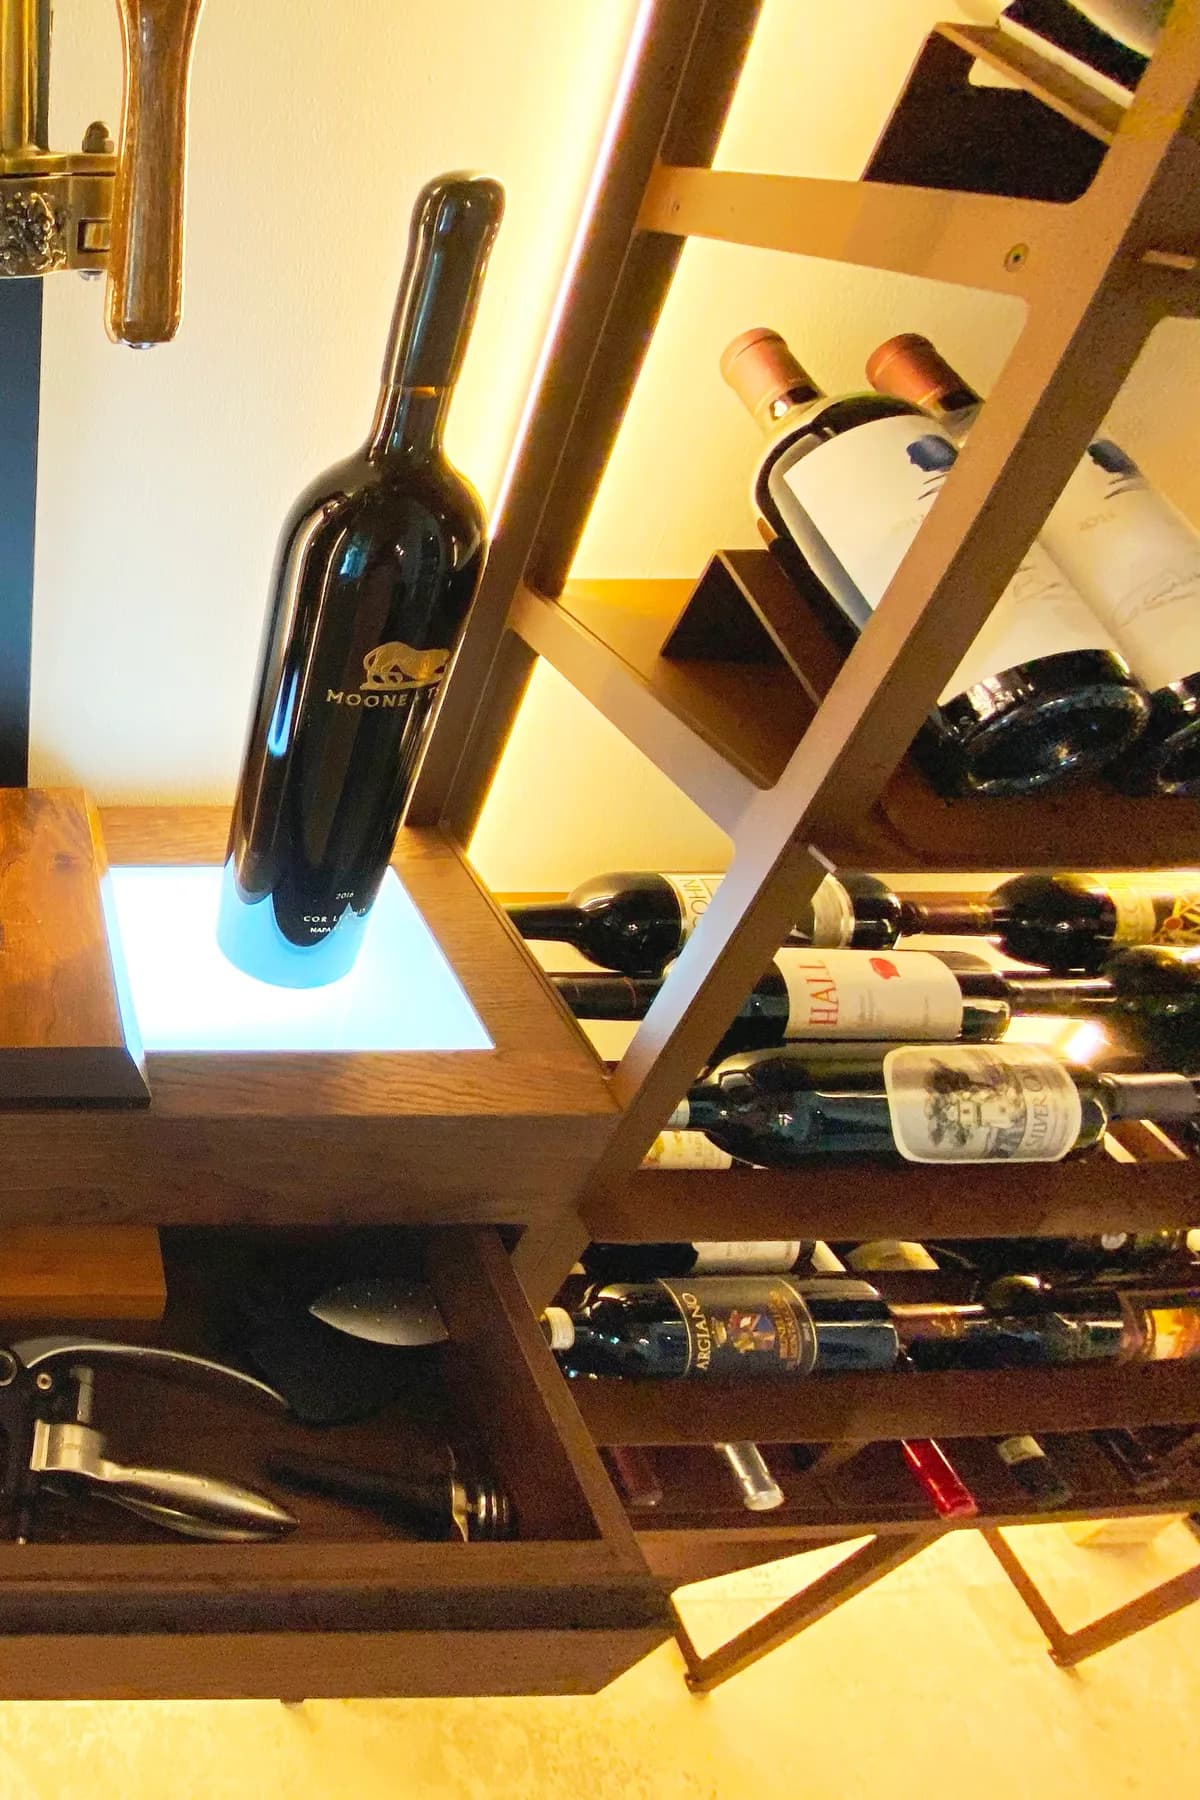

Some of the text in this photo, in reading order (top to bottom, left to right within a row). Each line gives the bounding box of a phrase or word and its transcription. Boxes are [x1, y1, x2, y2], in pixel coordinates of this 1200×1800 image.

[326, 689, 409, 708] MOONE
[303, 915, 328, 923] COR
[799, 958, 840, 1026] HALL
[1024, 1094, 1049, 1148] SILVER
[681, 1292, 712, 1371] ARGIANO
